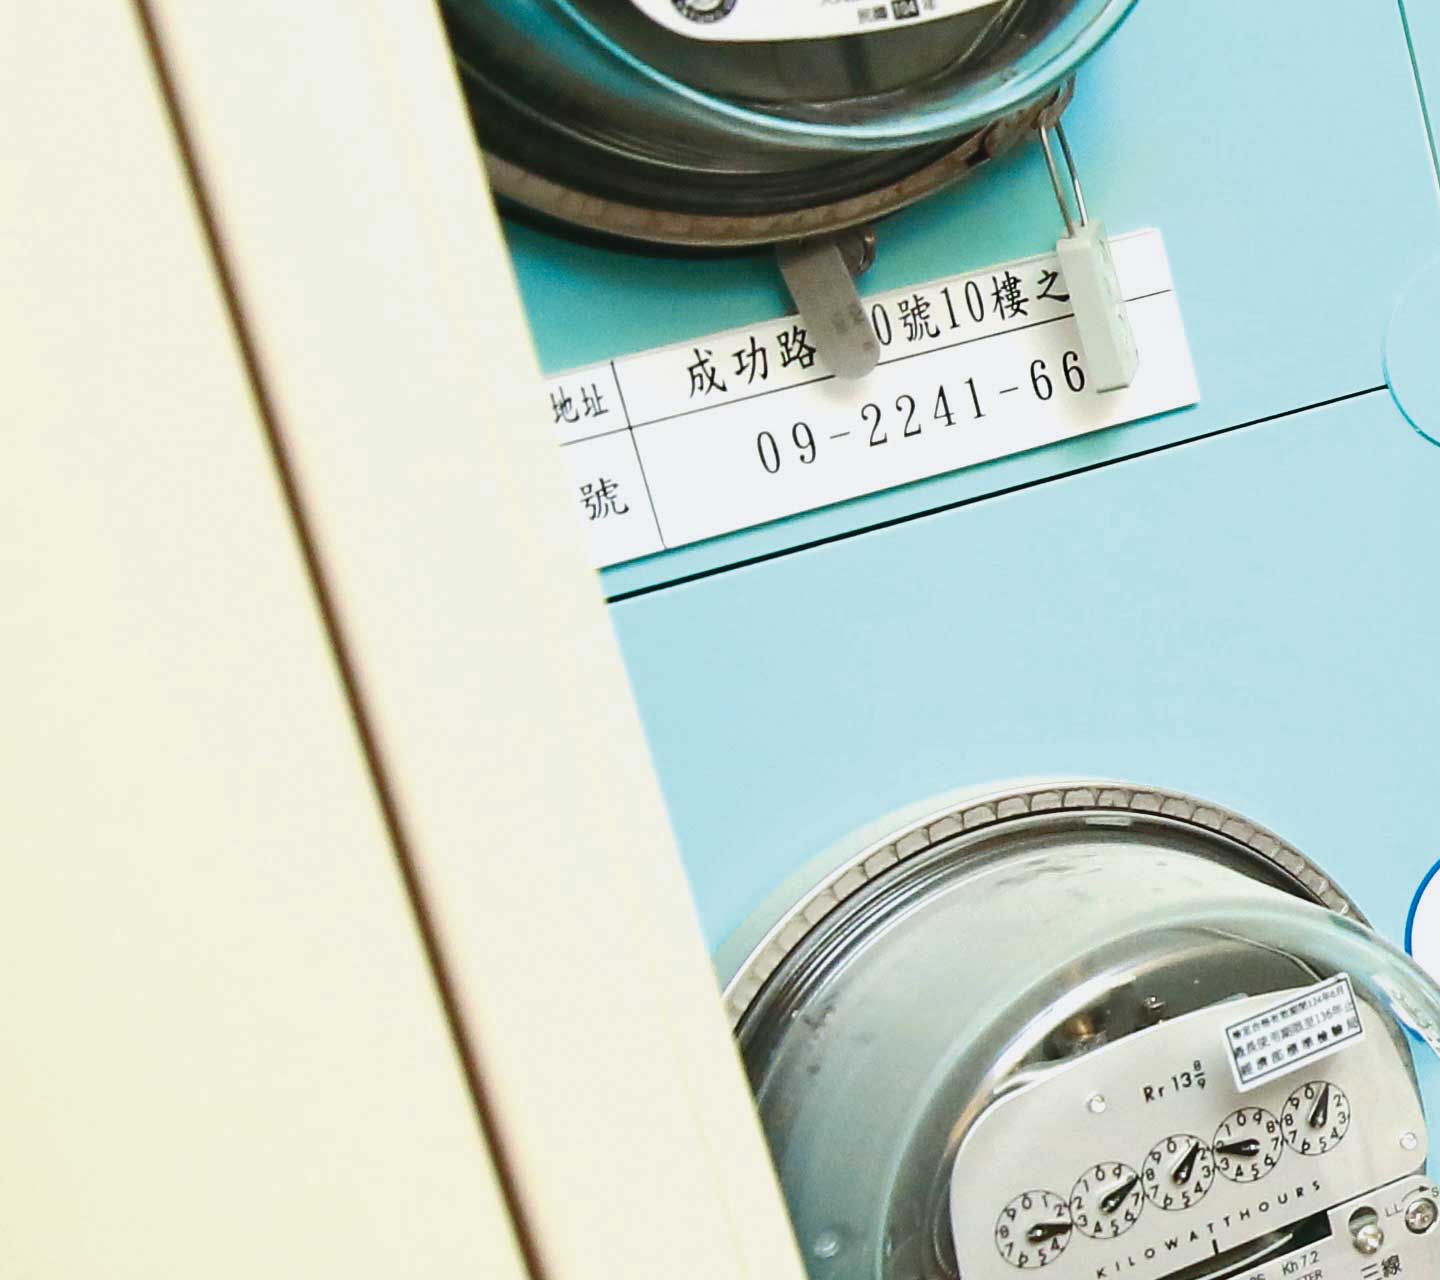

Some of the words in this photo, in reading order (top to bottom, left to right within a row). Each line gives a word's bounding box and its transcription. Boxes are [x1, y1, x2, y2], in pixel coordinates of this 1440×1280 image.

[686, 266, 1071, 399] 成功路0號10樓之
[549, 382, 610, 426] 地址
[754, 349, 1087, 476] 09-2241-66
[1143, 1082, 1164, 1103] Rr
[1172, 1070, 1192, 1091] 13
[1097, 1180, 1320, 1279] KILOWATTHOURS
[1282, 1260, 1300, 1277] Kh
[1301, 1250, 1320, 1269] 7.2
